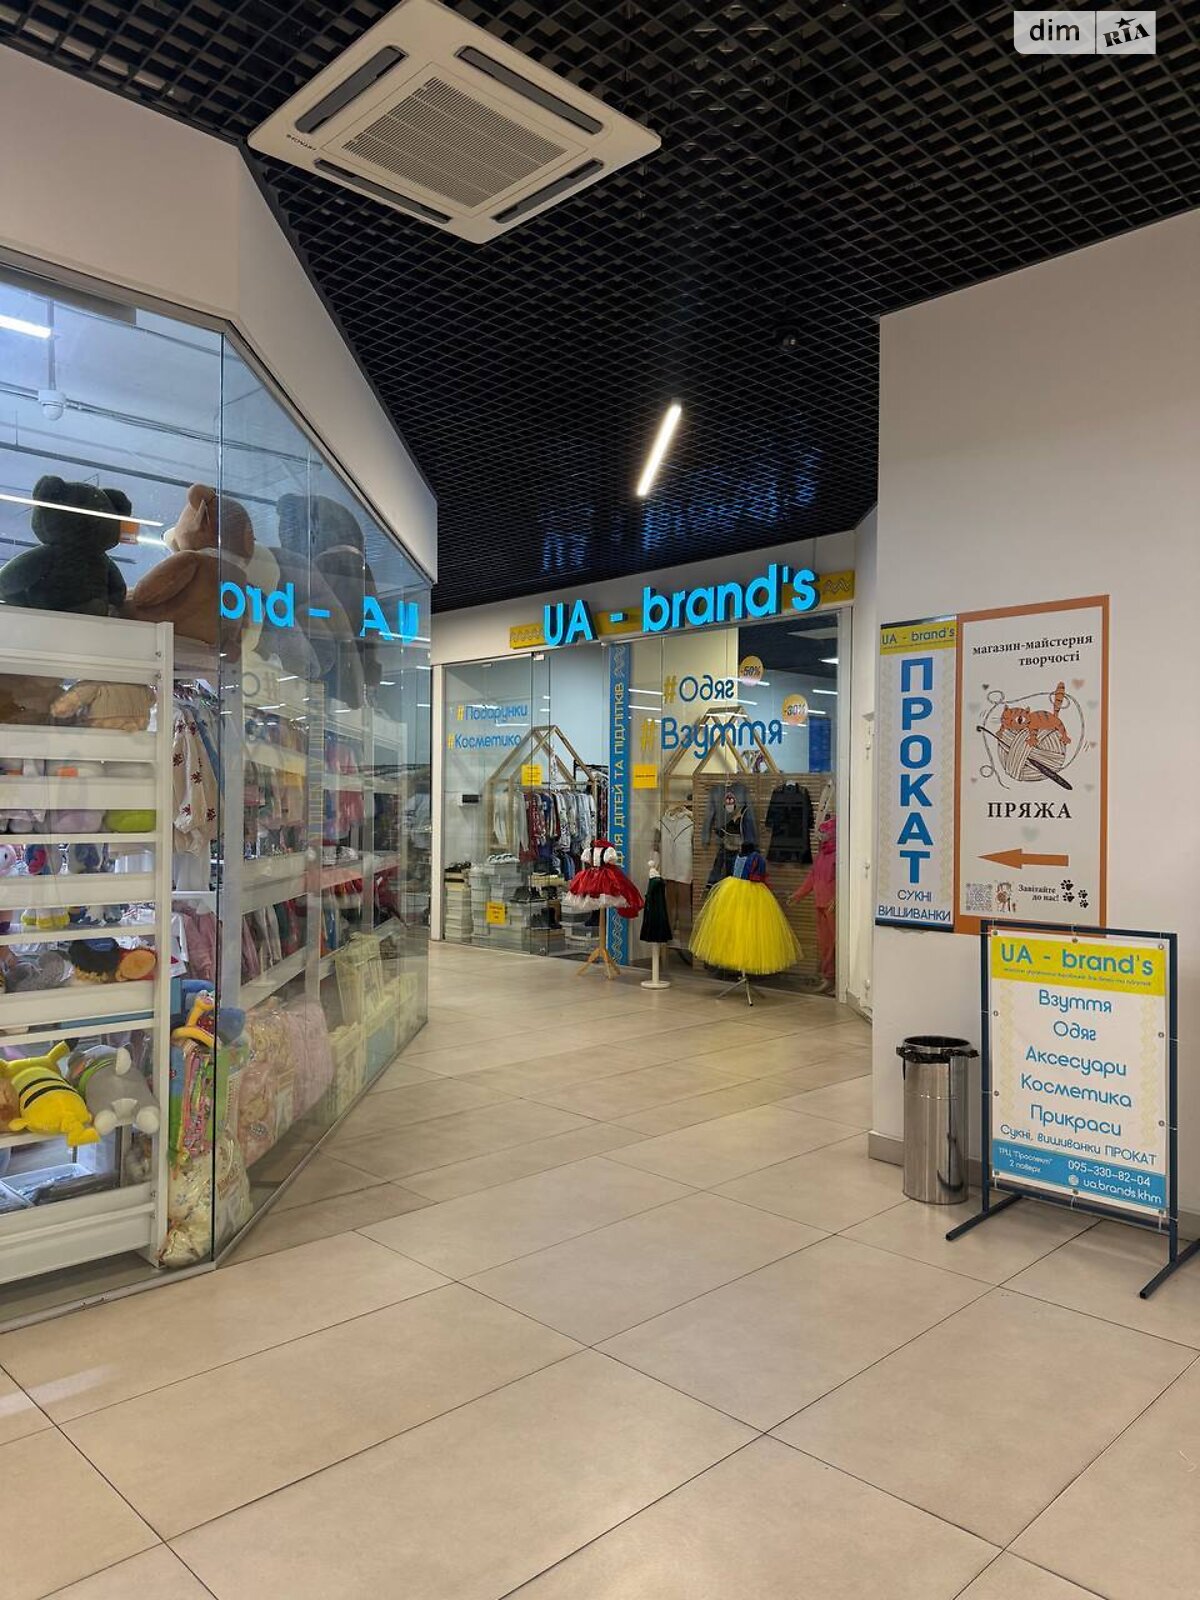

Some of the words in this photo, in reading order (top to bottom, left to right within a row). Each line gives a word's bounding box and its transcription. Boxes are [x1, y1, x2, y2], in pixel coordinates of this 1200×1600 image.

[544, 600, 597, 646] UA
[642, 563, 820, 633] brand's
[882, 633, 897, 646] UA
[911, 627, 955, 642] brand's
[972, 634, 1093, 655] магазин-майстерня
[1018, 650, 1080, 667] творчості
[613, 759, 626, 779] ТА
[897, 657, 934, 884] ПРОКАТ
[612, 784, 626, 828] ДІТЕЙ
[988, 801, 1072, 819] ПРЯЖА
[897, 889, 932, 902] СУКНІ
[878, 904, 951, 922] ВИШИВАНКИ
[1001, 943, 1032, 964] UA
[1062, 949, 1153, 976] brand's
[1038, 989, 1112, 1013] Взуття
[1053, 1020, 1096, 1041] Одяг
[1025, 1046, 1127, 1079] Аксесуари
[1021, 1073, 1132, 1108] Косметика
[1030, 1104, 1121, 1137] Прикраси
[1000, 1124, 1034, 1142] Сукні,
[1105, 1145, 1158, 1166] ПРОКАТ
[1068, 1159, 1151, 1187] 095-330-82-04
